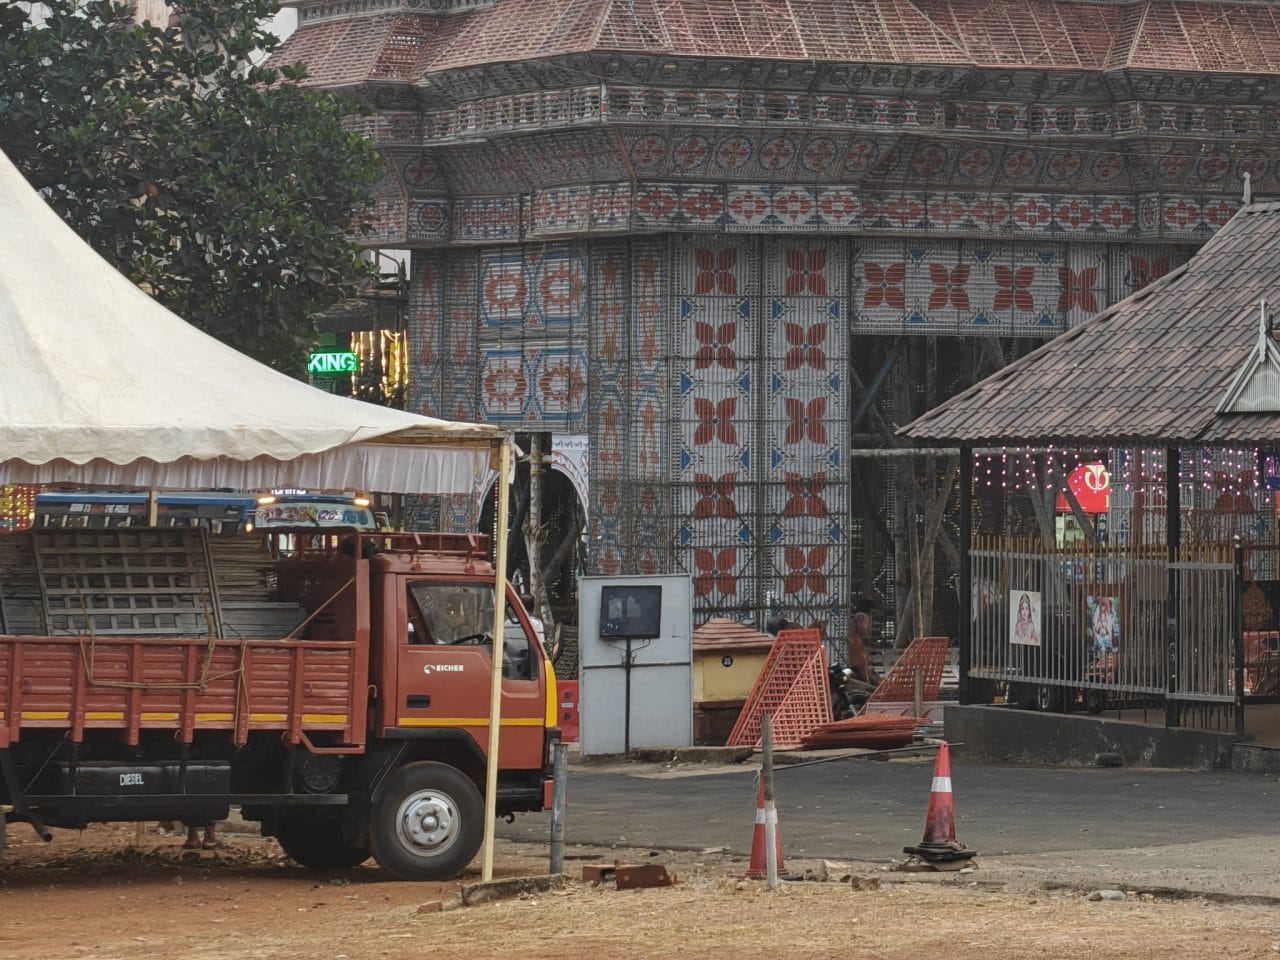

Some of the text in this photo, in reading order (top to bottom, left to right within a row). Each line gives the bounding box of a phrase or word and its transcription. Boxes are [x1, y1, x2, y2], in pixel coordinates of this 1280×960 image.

[309, 353, 355, 371] KING
[436, 664, 464, 672] EICHER
[120, 773, 145, 786] DIESEL
